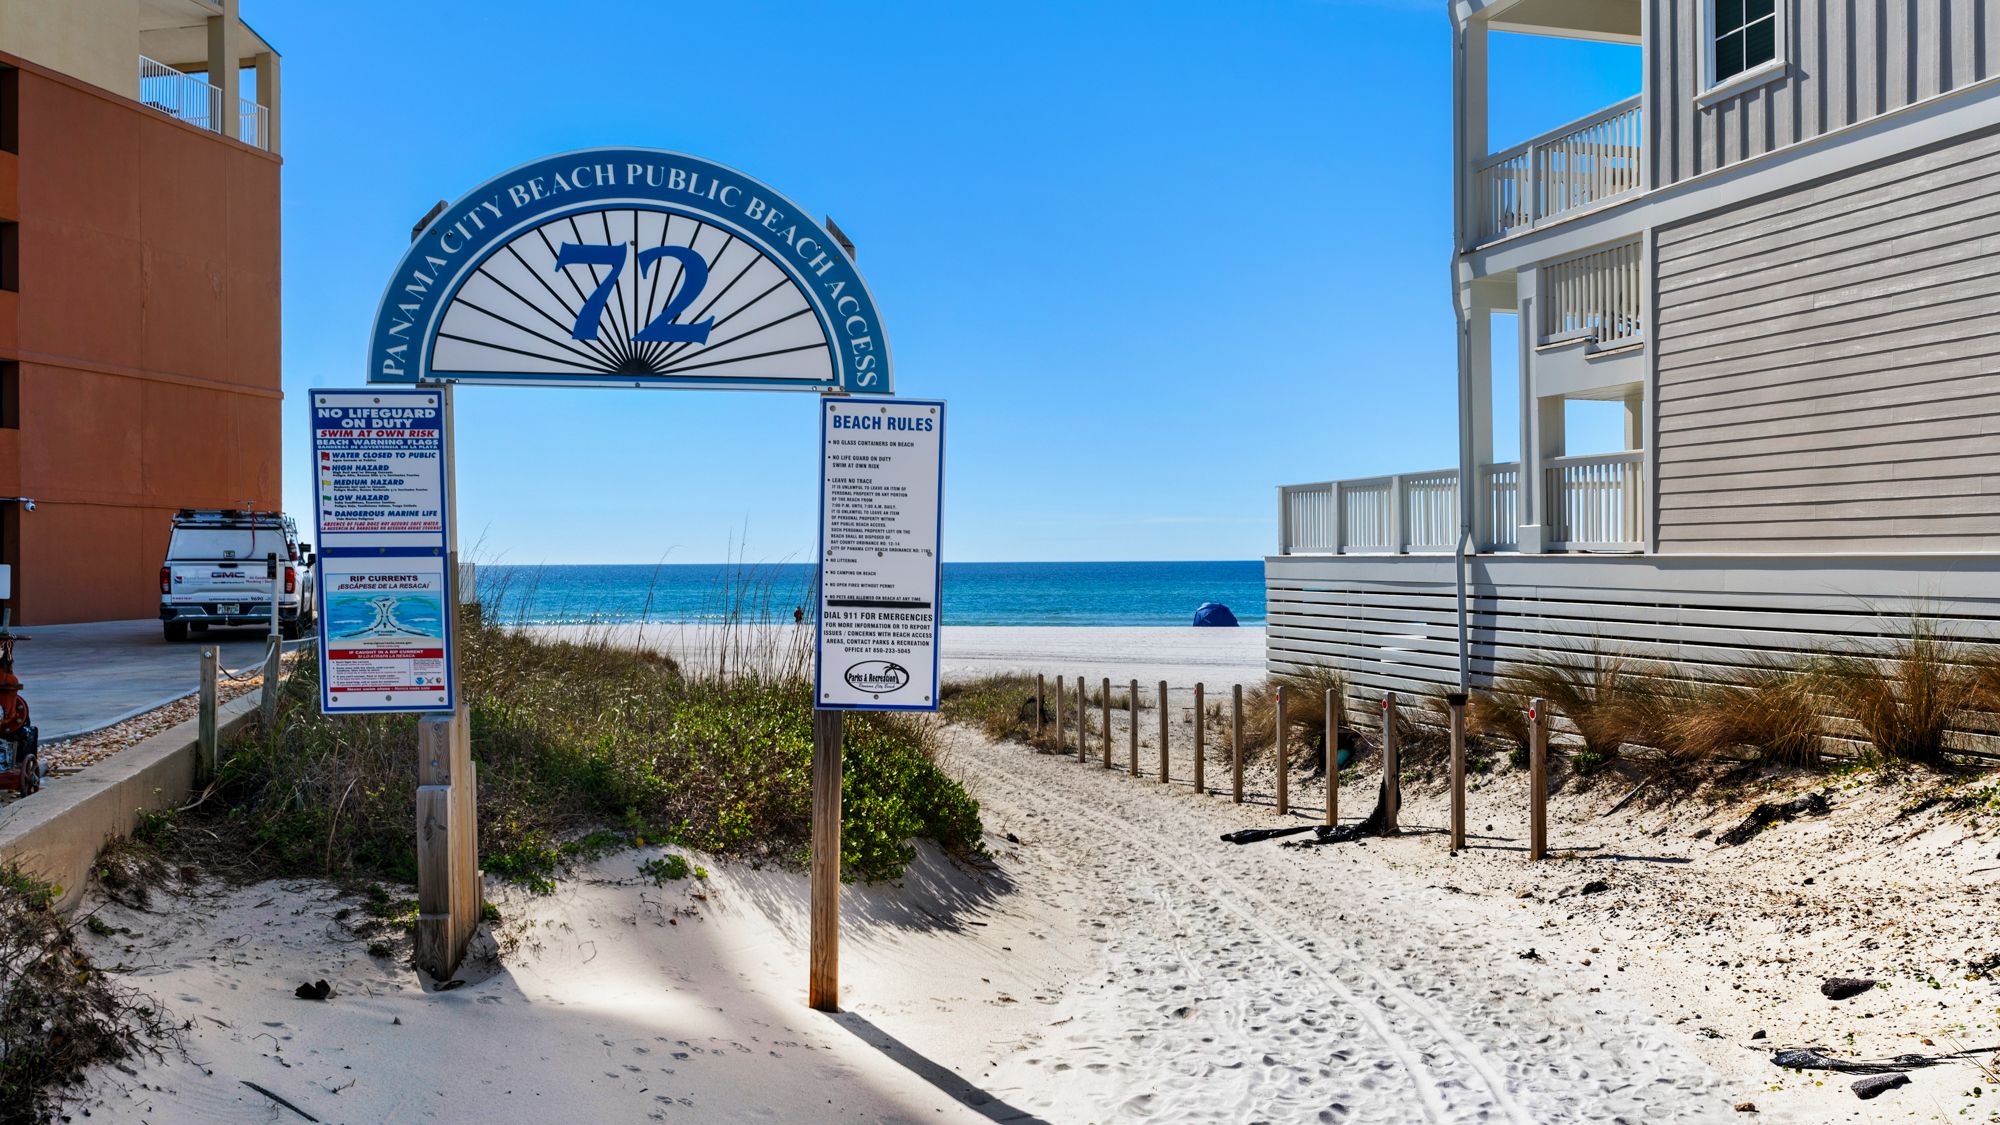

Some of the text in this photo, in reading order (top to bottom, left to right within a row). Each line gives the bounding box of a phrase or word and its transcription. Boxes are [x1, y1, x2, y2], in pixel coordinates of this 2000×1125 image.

[383, 164, 878, 387] PANAMA CITY BEACH PUBLIC BEACH ACCESS
[554, 241, 716, 346] 72
[318, 409, 435, 418] NO LIFEGUARD
[342, 419, 413, 428] ON DUTY
[833, 415, 932, 431] BEACH RULES
[879, 613, 932, 622] EMERGENCIES
[849, 673, 862, 682] Parks
[869, 673, 895, 683] Recreation
